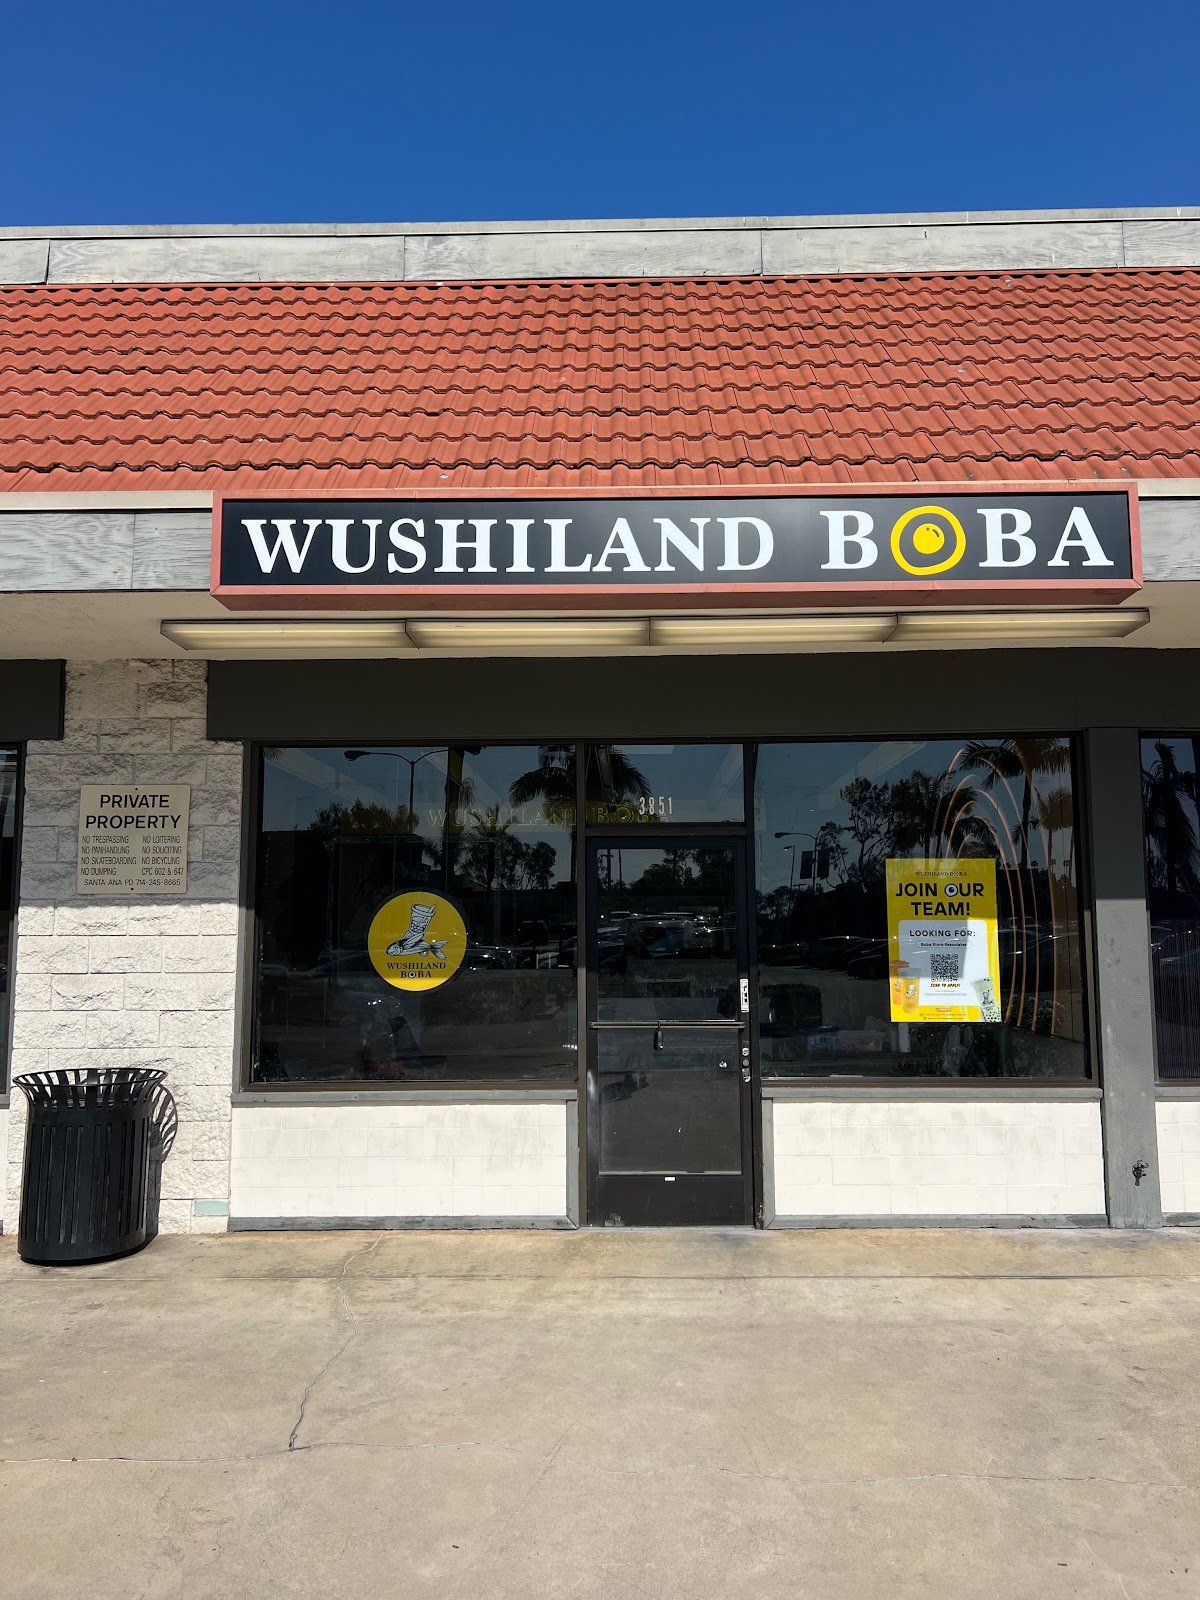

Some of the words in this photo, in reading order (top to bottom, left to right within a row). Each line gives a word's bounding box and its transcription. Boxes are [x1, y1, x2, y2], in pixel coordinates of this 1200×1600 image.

[240, 517, 774, 574] WUSHILAND
[819, 505, 1115, 576] BOBA
[100, 794, 170, 808] PRIVATE
[638, 796, 673, 815] 3851
[85, 815, 182, 829] PROPERTY
[82, 835, 91, 844] NO
[92, 835, 129, 844] TRESPASSING
[142, 835, 151, 844] NO
[152, 835, 181, 844] LOITERING
[81, 846, 90, 854] NO
[91, 846, 130, 855] PANHANDLING
[142, 846, 151, 854] NO
[152, 846, 182, 855] SOLICITING
[81, 856, 90, 865] NO
[91, 856, 137, 865] SKATEBOARDING
[141, 856, 150, 865] NO
[151, 856, 180, 865] BICYCLING
[80, 867, 90, 876] NO
[91, 867, 117, 876] DUMPING
[141, 867, 153, 876] CPC
[154, 867, 166, 876] 602
[167, 867, 172, 876] &
[173, 867, 184, 876] 647
[895, 882, 938, 897] JOIN
[944, 882, 985, 898] OUR
[910, 901, 971, 916] TEAM!
[386, 962, 446, 970] WUSHILAND
[400, 970, 432, 979] BOBA
